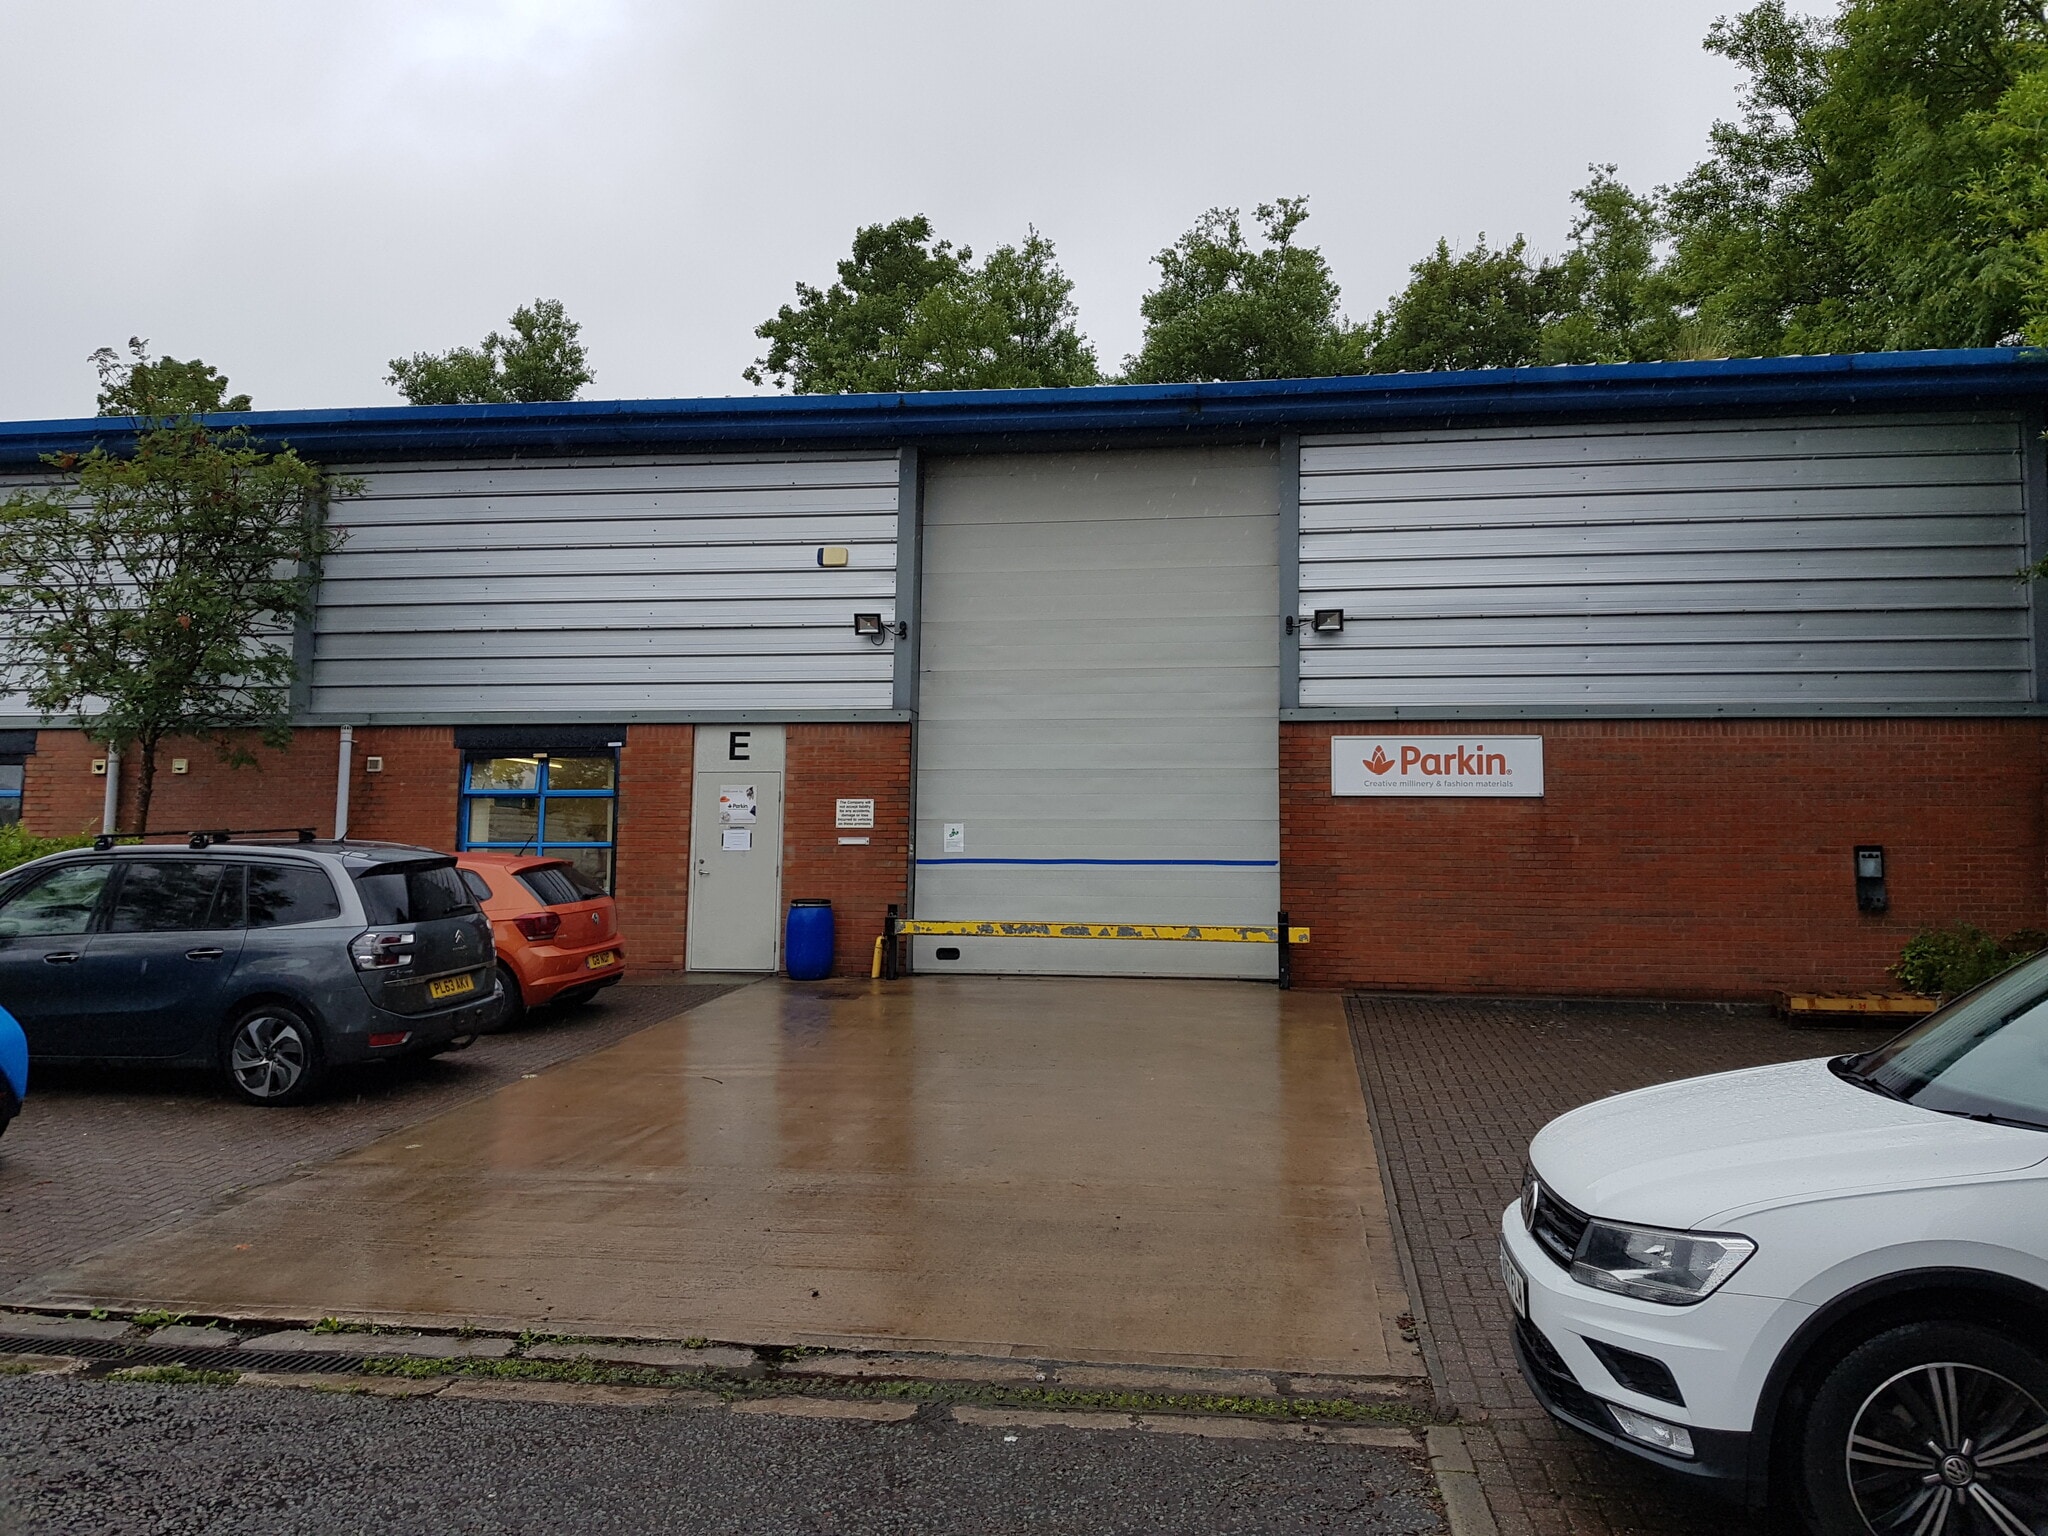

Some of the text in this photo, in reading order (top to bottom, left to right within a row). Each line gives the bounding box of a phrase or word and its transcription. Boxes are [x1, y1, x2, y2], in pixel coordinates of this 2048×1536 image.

[729, 732, 751, 760] E
[1400, 745, 1507, 775] Parkin
[1400, 780, 1434, 788] millinery
